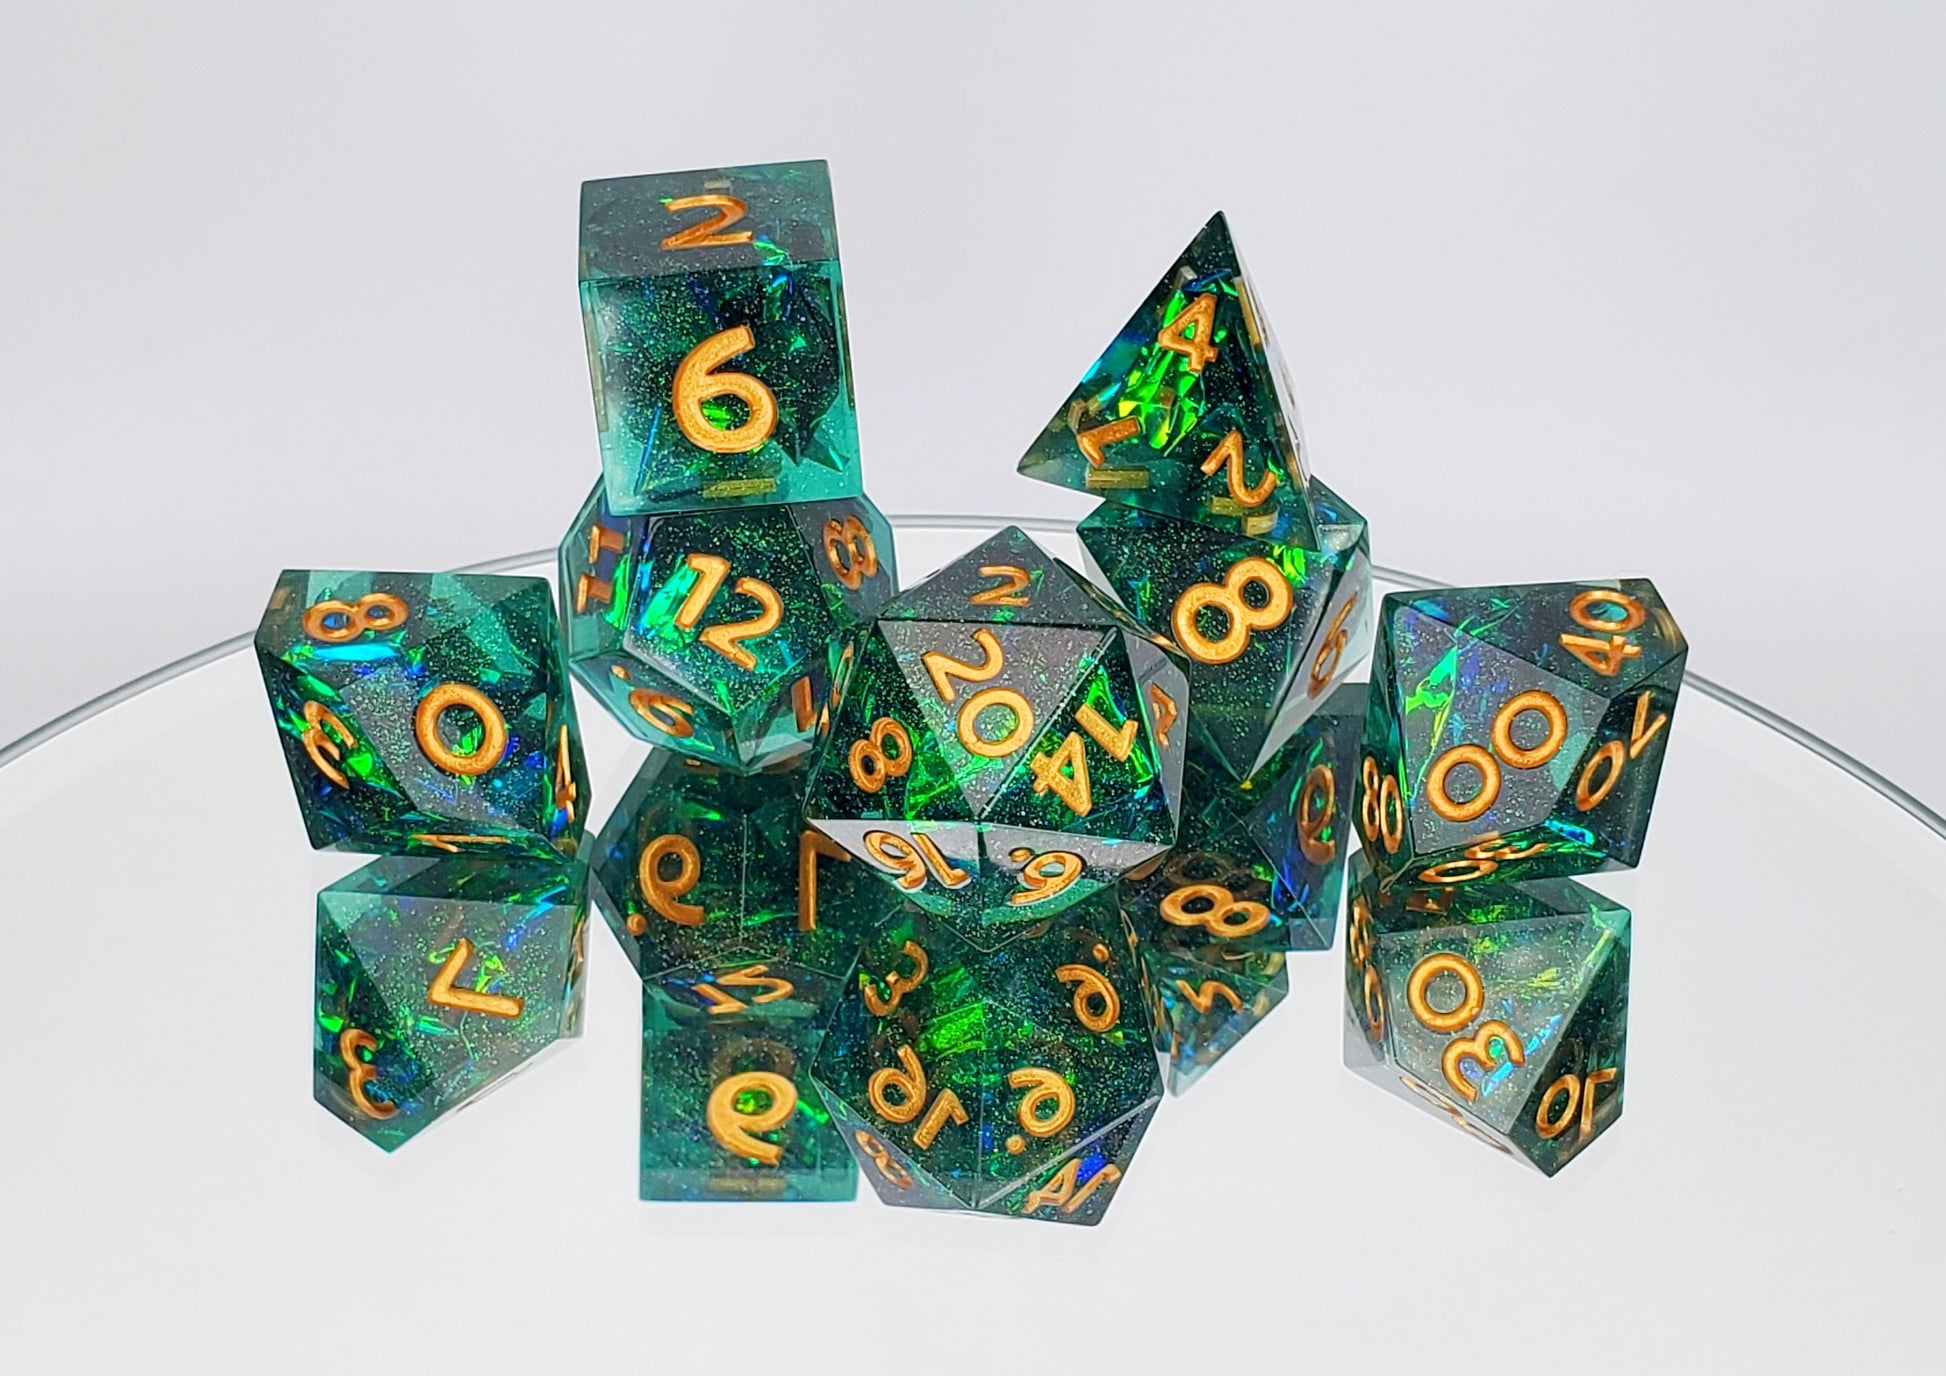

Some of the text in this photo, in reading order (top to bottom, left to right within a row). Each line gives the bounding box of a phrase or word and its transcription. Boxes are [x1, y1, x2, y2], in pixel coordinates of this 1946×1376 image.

[661, 194, 754, 250] 2
[1158, 293, 1218, 374] 4
[672, 324, 778, 453] 6
[1200, 430, 1278, 507] 2
[823, 515, 878, 590] 8
[970, 566, 1032, 606] 2
[303, 592, 408, 643] 8
[674, 553, 784, 671] 12
[1172, 557, 1293, 664] 8
[1559, 590, 1645, 676] 40
[415, 683, 507, 776] 0
[921, 628, 1034, 758] 20
[302, 701, 357, 789] 3
[850, 717, 912, 793] 8
[1030, 702, 1138, 817] 14
[1426, 690, 1568, 822] 00
[1363, 756, 1404, 854] 80
